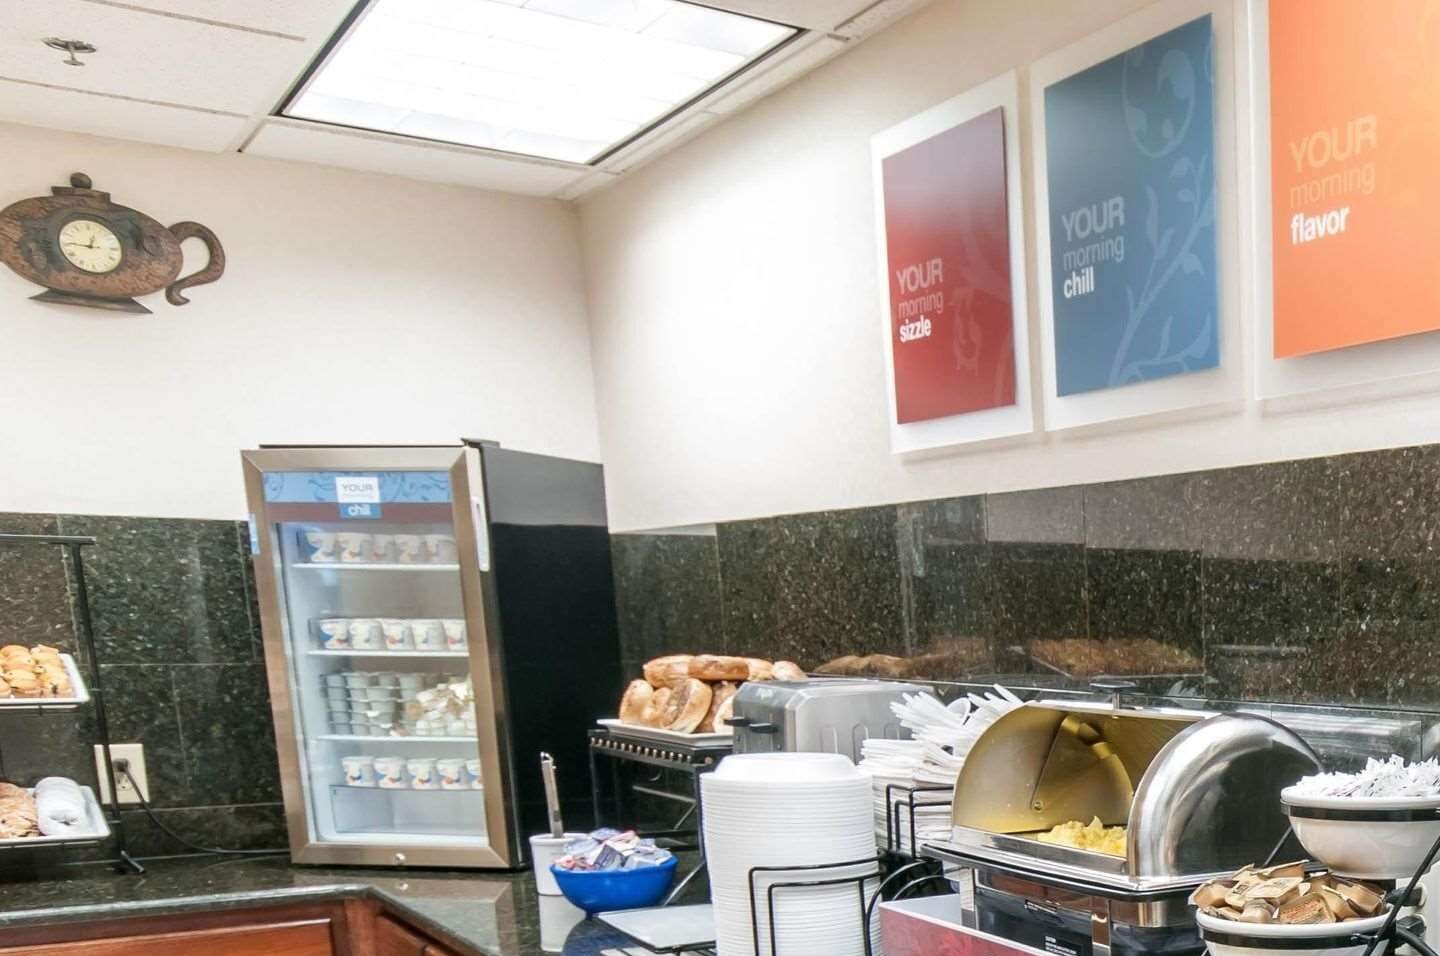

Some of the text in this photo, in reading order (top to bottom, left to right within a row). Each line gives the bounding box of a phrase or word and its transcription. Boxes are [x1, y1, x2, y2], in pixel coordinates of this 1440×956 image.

[1288, 114, 1377, 173] YOUR
[1289, 161, 1376, 209] morning
[1062, 196, 1125, 242] YOUR
[1290, 206, 1350, 245] flavor
[1063, 235, 1125, 271] morning
[896, 258, 943, 295] YOUR
[1063, 266, 1095, 298] chill
[898, 292, 944, 318] morning
[900, 315, 932, 343] sizzle
